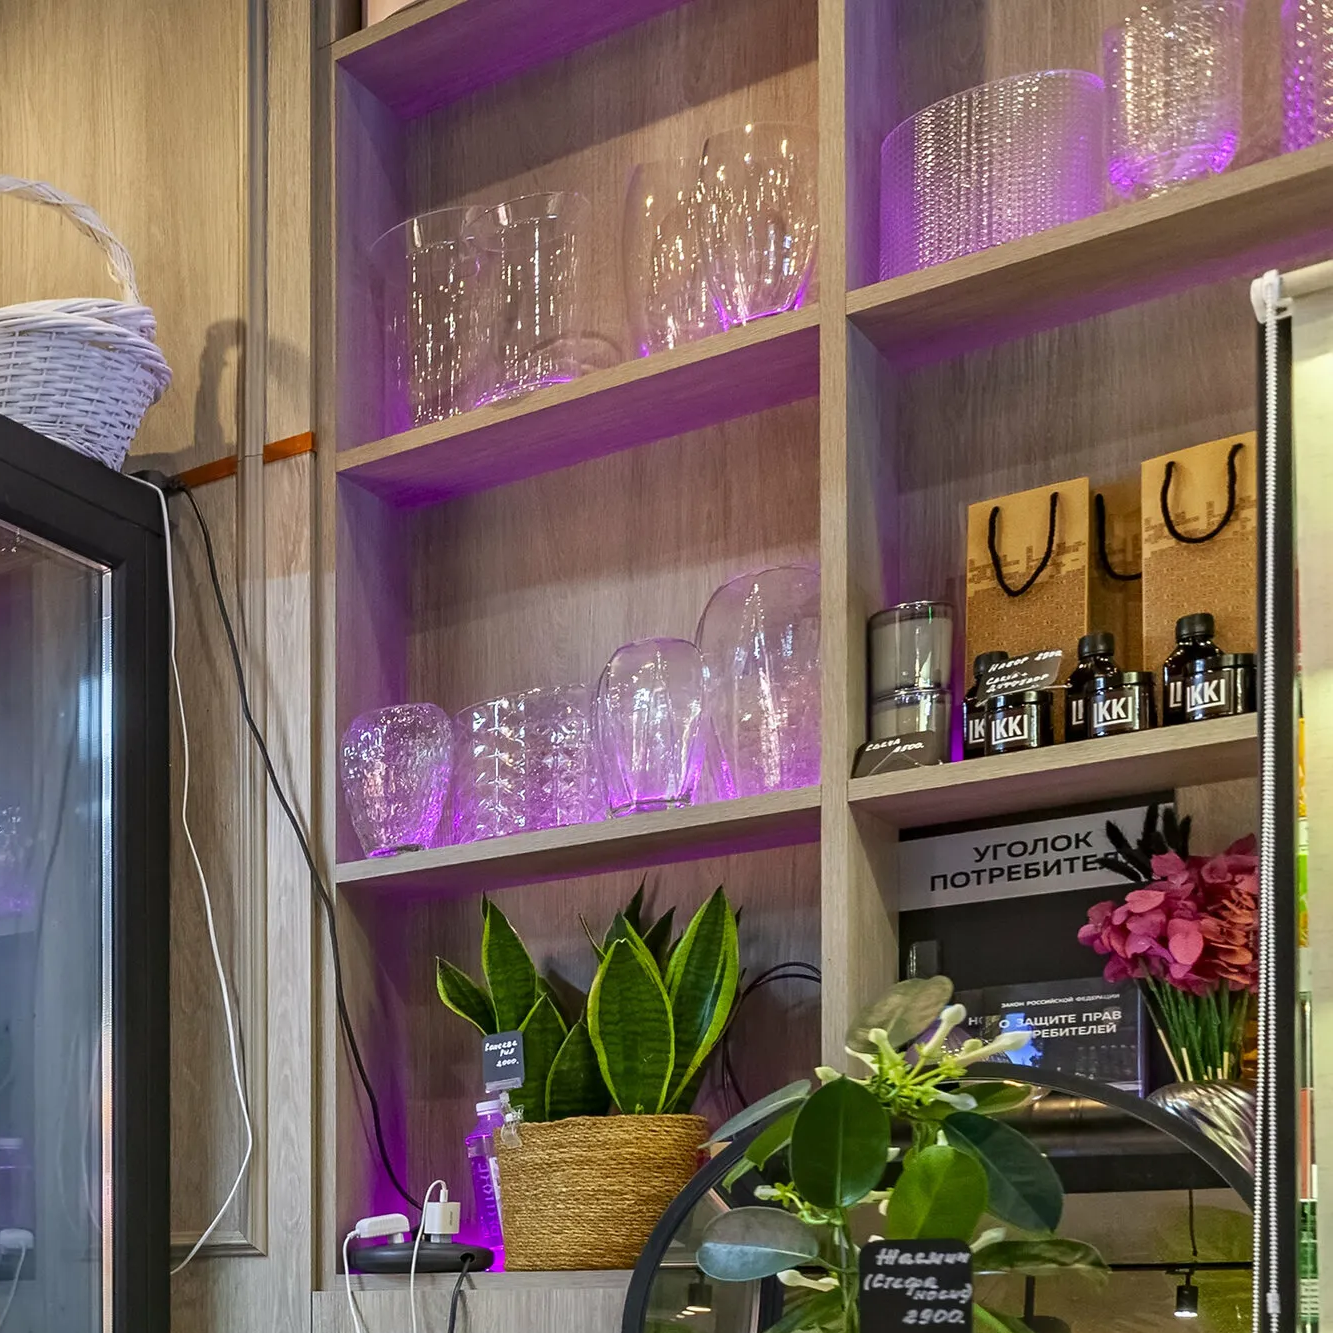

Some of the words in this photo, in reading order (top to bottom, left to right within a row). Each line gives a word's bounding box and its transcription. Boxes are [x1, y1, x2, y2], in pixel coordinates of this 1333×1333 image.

[972, 830, 1093, 863] УГОЛОК
[930, 852, 1121, 892] ПОТРЕБИТЕЛ
[1001, 1000, 1025, 1009] ЗАКОН
[1026, 996, 1074, 1007] РОССИЙСКОЙ
[998, 1018, 1010, 1029] О
[1016, 1014, 1077, 1029] ЗАЩИТЕ
[1082, 1010, 1122, 1023] ПРАВ
[1032, 1022, 1118, 1039] РЕБИТЕЛЕЙ
